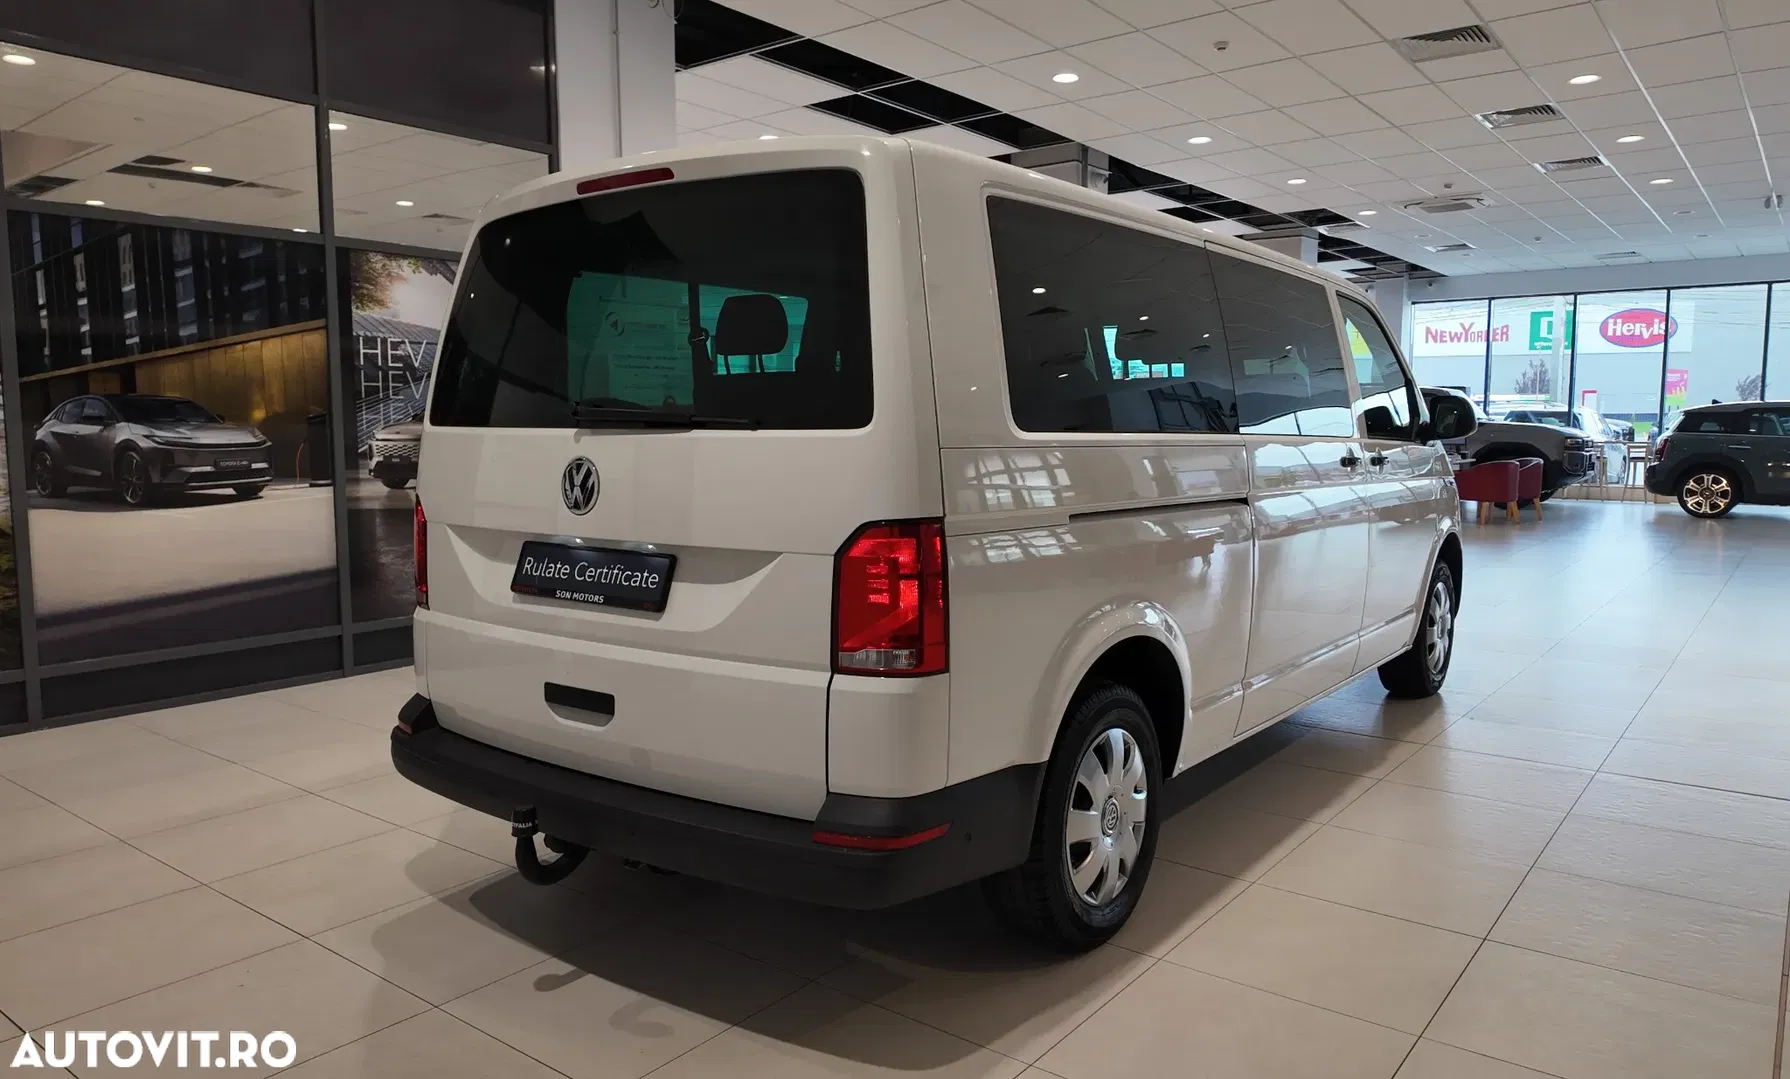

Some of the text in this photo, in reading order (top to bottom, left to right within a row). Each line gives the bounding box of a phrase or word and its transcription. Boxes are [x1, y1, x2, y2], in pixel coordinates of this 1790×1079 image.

[359, 336, 427, 368] HEV
[361, 369, 428, 400] HEV
[522, 557, 659, 588] Rulate Certificate
[555, 589, 605, 604] SON MOTORS
